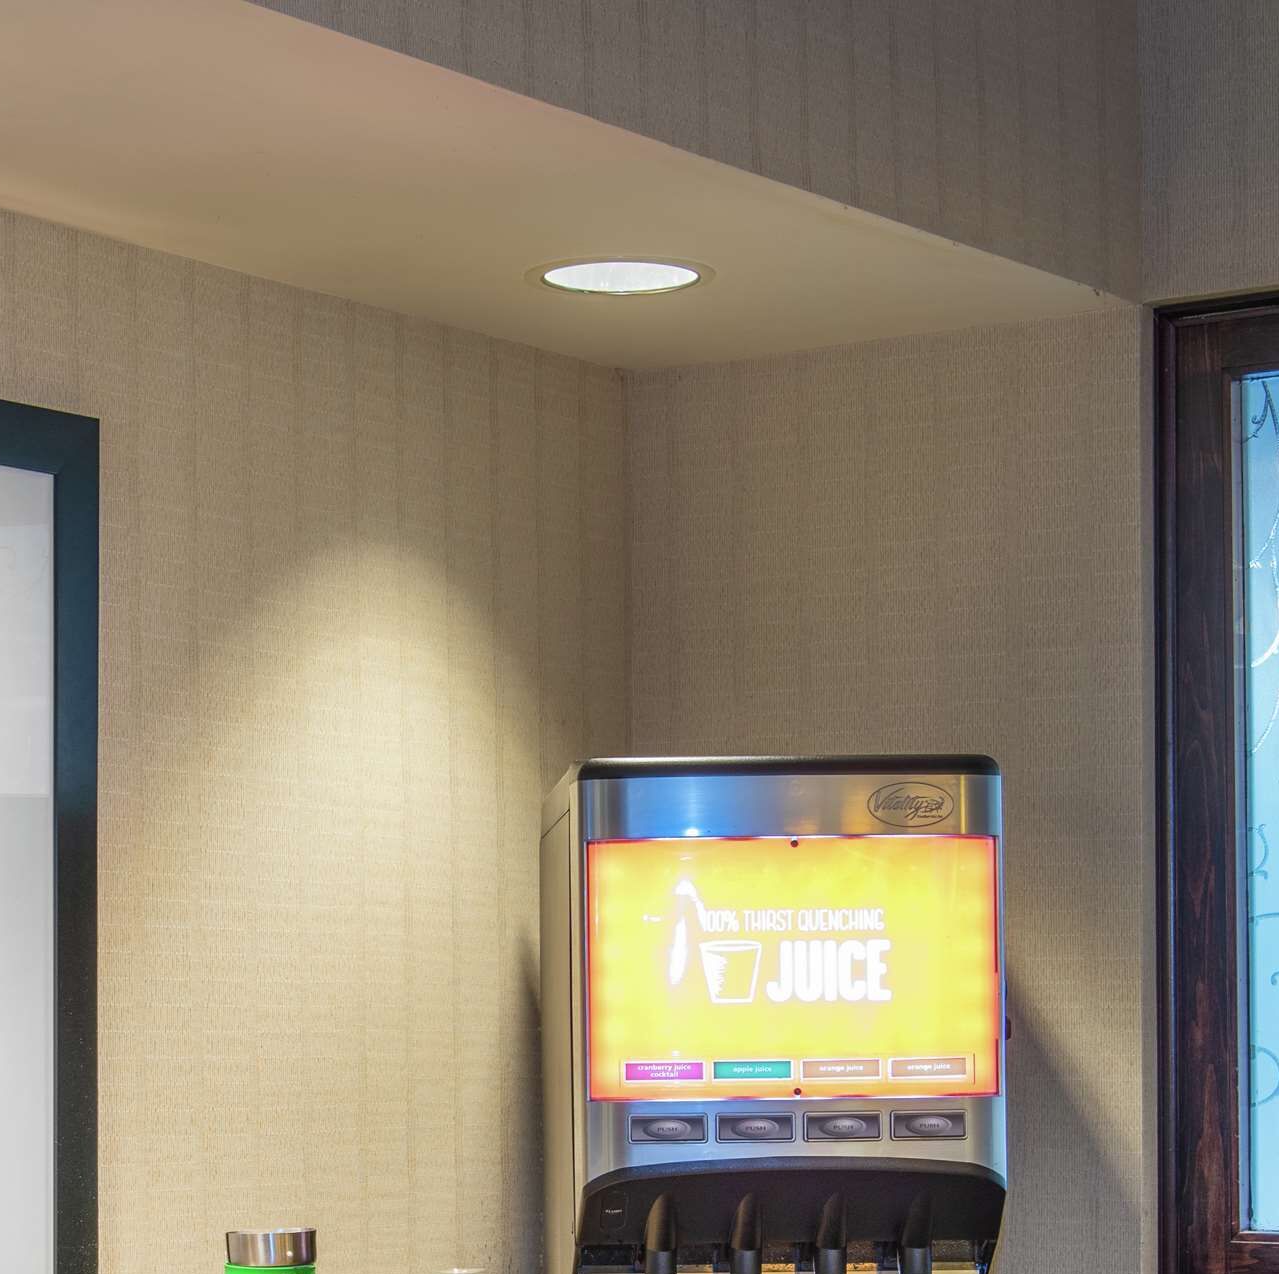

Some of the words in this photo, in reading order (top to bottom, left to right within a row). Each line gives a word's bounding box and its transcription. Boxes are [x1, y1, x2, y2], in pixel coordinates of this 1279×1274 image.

[743, 908, 795, 932] THIRST
[798, 907, 885, 932] QUENCHING
[765, 938, 893, 1003] JUICE
[637, 1062, 672, 1073] cranberry
[673, 1062, 692, 1073] juice
[732, 1064, 753, 1075] apple
[754, 1064, 773, 1074] juice
[819, 1063, 845, 1074] orange
[846, 1062, 864, 1073] juice
[906, 1062, 933, 1073] orange
[933, 1061, 951, 1072] juice
[650, 1070, 680, 1078] cocktail
